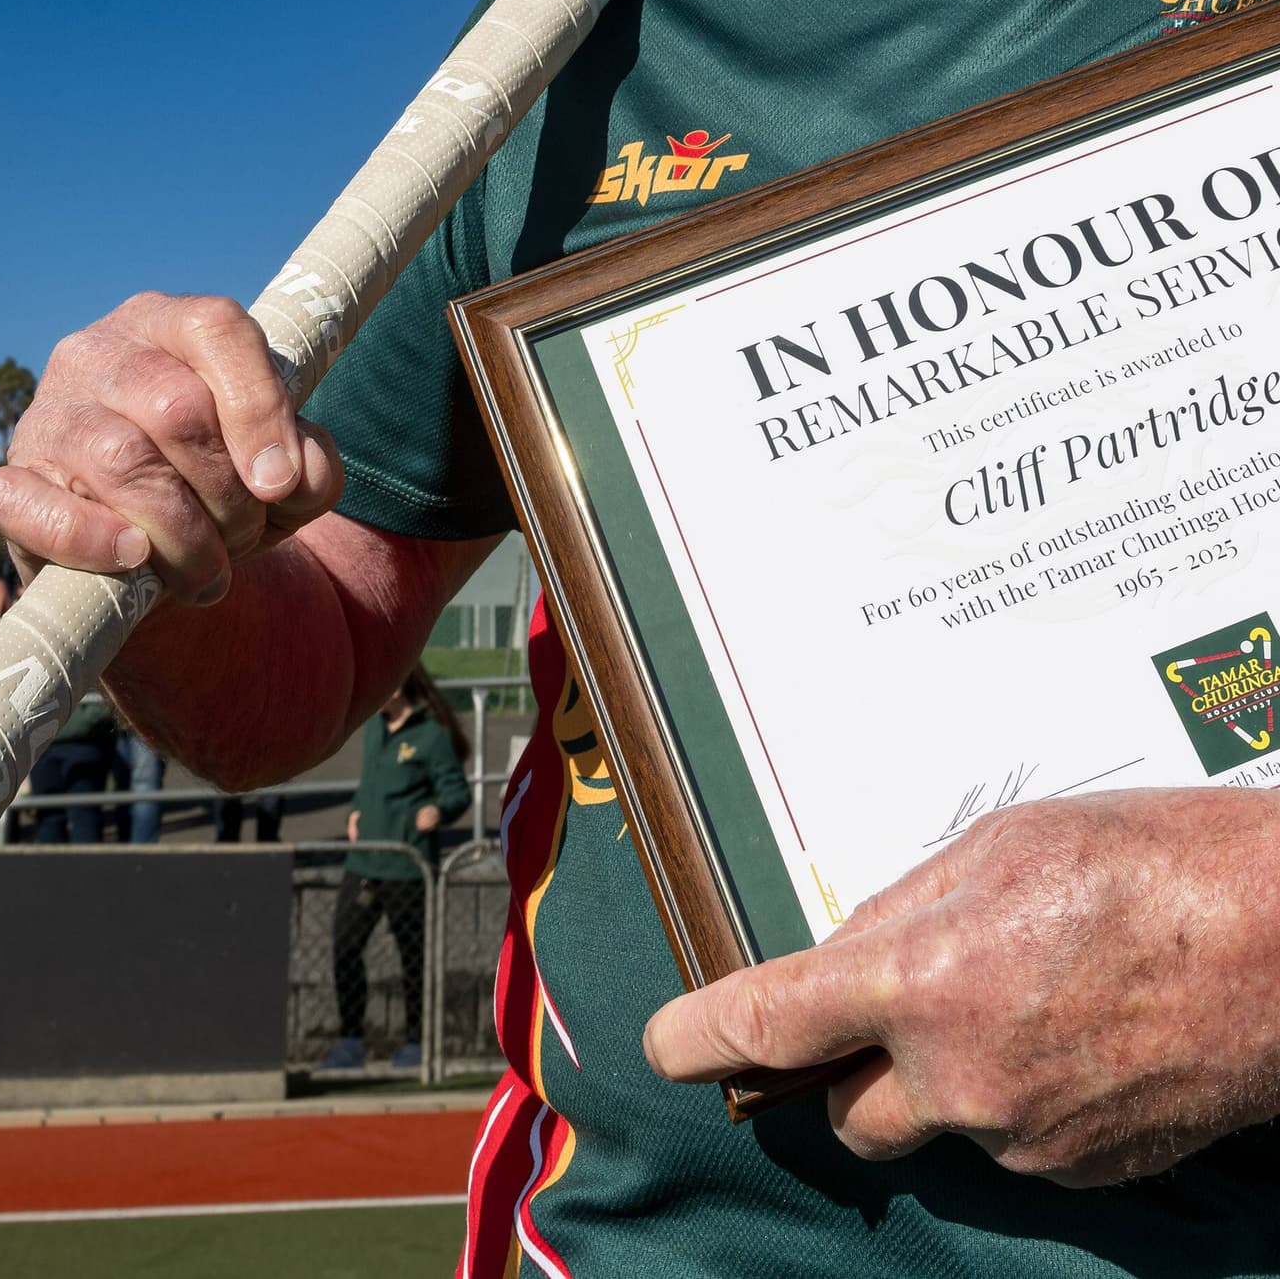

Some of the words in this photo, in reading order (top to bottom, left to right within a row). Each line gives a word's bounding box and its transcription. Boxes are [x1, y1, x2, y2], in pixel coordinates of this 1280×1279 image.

[736, 320, 832, 402] IN
[838, 193, 1199, 363] HONOUR
[755, 292, 1122, 462] REMARKABLE
[922, 423, 976, 453] This
[980, 379, 1093, 433] certificate
[1094, 369, 1118, 388] is
[1121, 327, 1217, 379] awarded
[1217, 323, 1243, 341] to
[944, 444, 1047, 526] Cliff
[861, 598, 902, 626] For
[908, 586, 937, 608] 60
[941, 560, 1005, 600] years
[1009, 541, 1033, 568] of
[1038, 492, 1177, 557] outstanding
[940, 595, 996, 629] with
[998, 582, 1038, 607] the
[1038, 549, 1116, 590] Tamar
[1121, 507, 1231, 558] Churinga
[1115, 568, 1164, 599] 1965
[1186, 538, 1238, 571] 2025
[1198, 658, 1264, 693] TAMAR
[1205, 697, 1248, 719] HOCKEY
[1253, 685, 1280, 700] CLUB
[1222, 711, 1241, 723] EST
